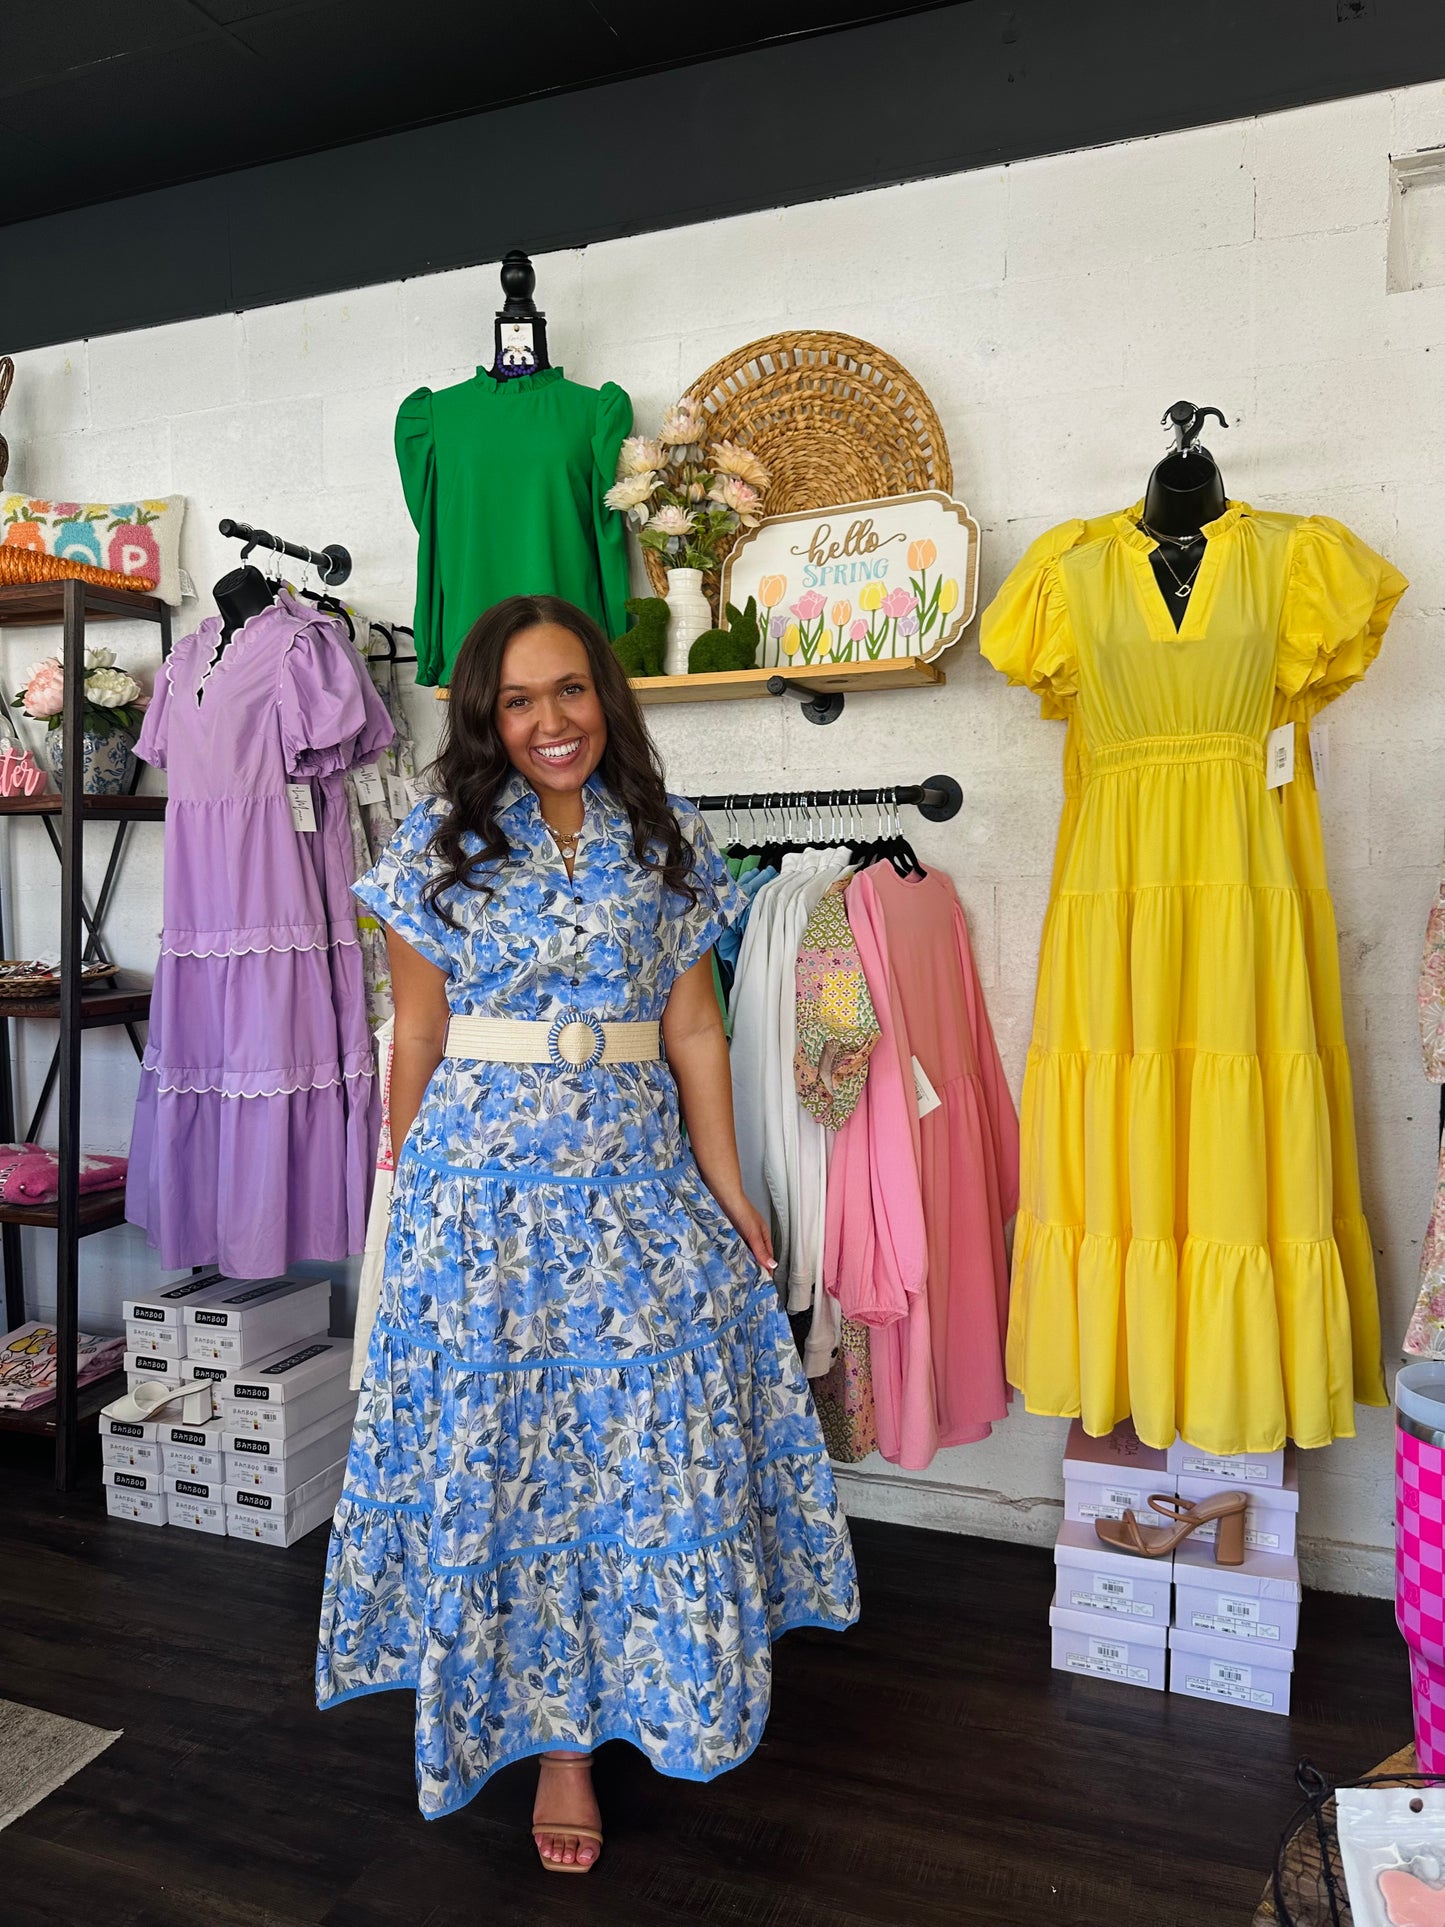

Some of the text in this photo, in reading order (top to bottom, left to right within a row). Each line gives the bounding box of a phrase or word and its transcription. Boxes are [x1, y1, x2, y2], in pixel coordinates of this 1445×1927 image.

[790, 518, 907, 567] hello
[802, 557, 889, 588] SPRING
[0, 747, 40, 797] ter
[135, 1309, 163, 1319] BAMBOO
[196, 1314, 226, 1324] BAMBOO
[137, 1360, 166, 1369] BAMBOO
[195, 1369, 225, 1380] BAMBOO
[236, 1387, 267, 1397] BAMBOO
[112, 1425, 142, 1435] BAMBOO
[172, 1432, 204, 1443] BAMBOO
[236, 1441, 267, 1452] BAMBOO
[115, 1475, 145, 1487] BAMBOO
[177, 1483, 207, 1495] BAMBOO
[238, 1495, 270, 1507] BAMBOO
